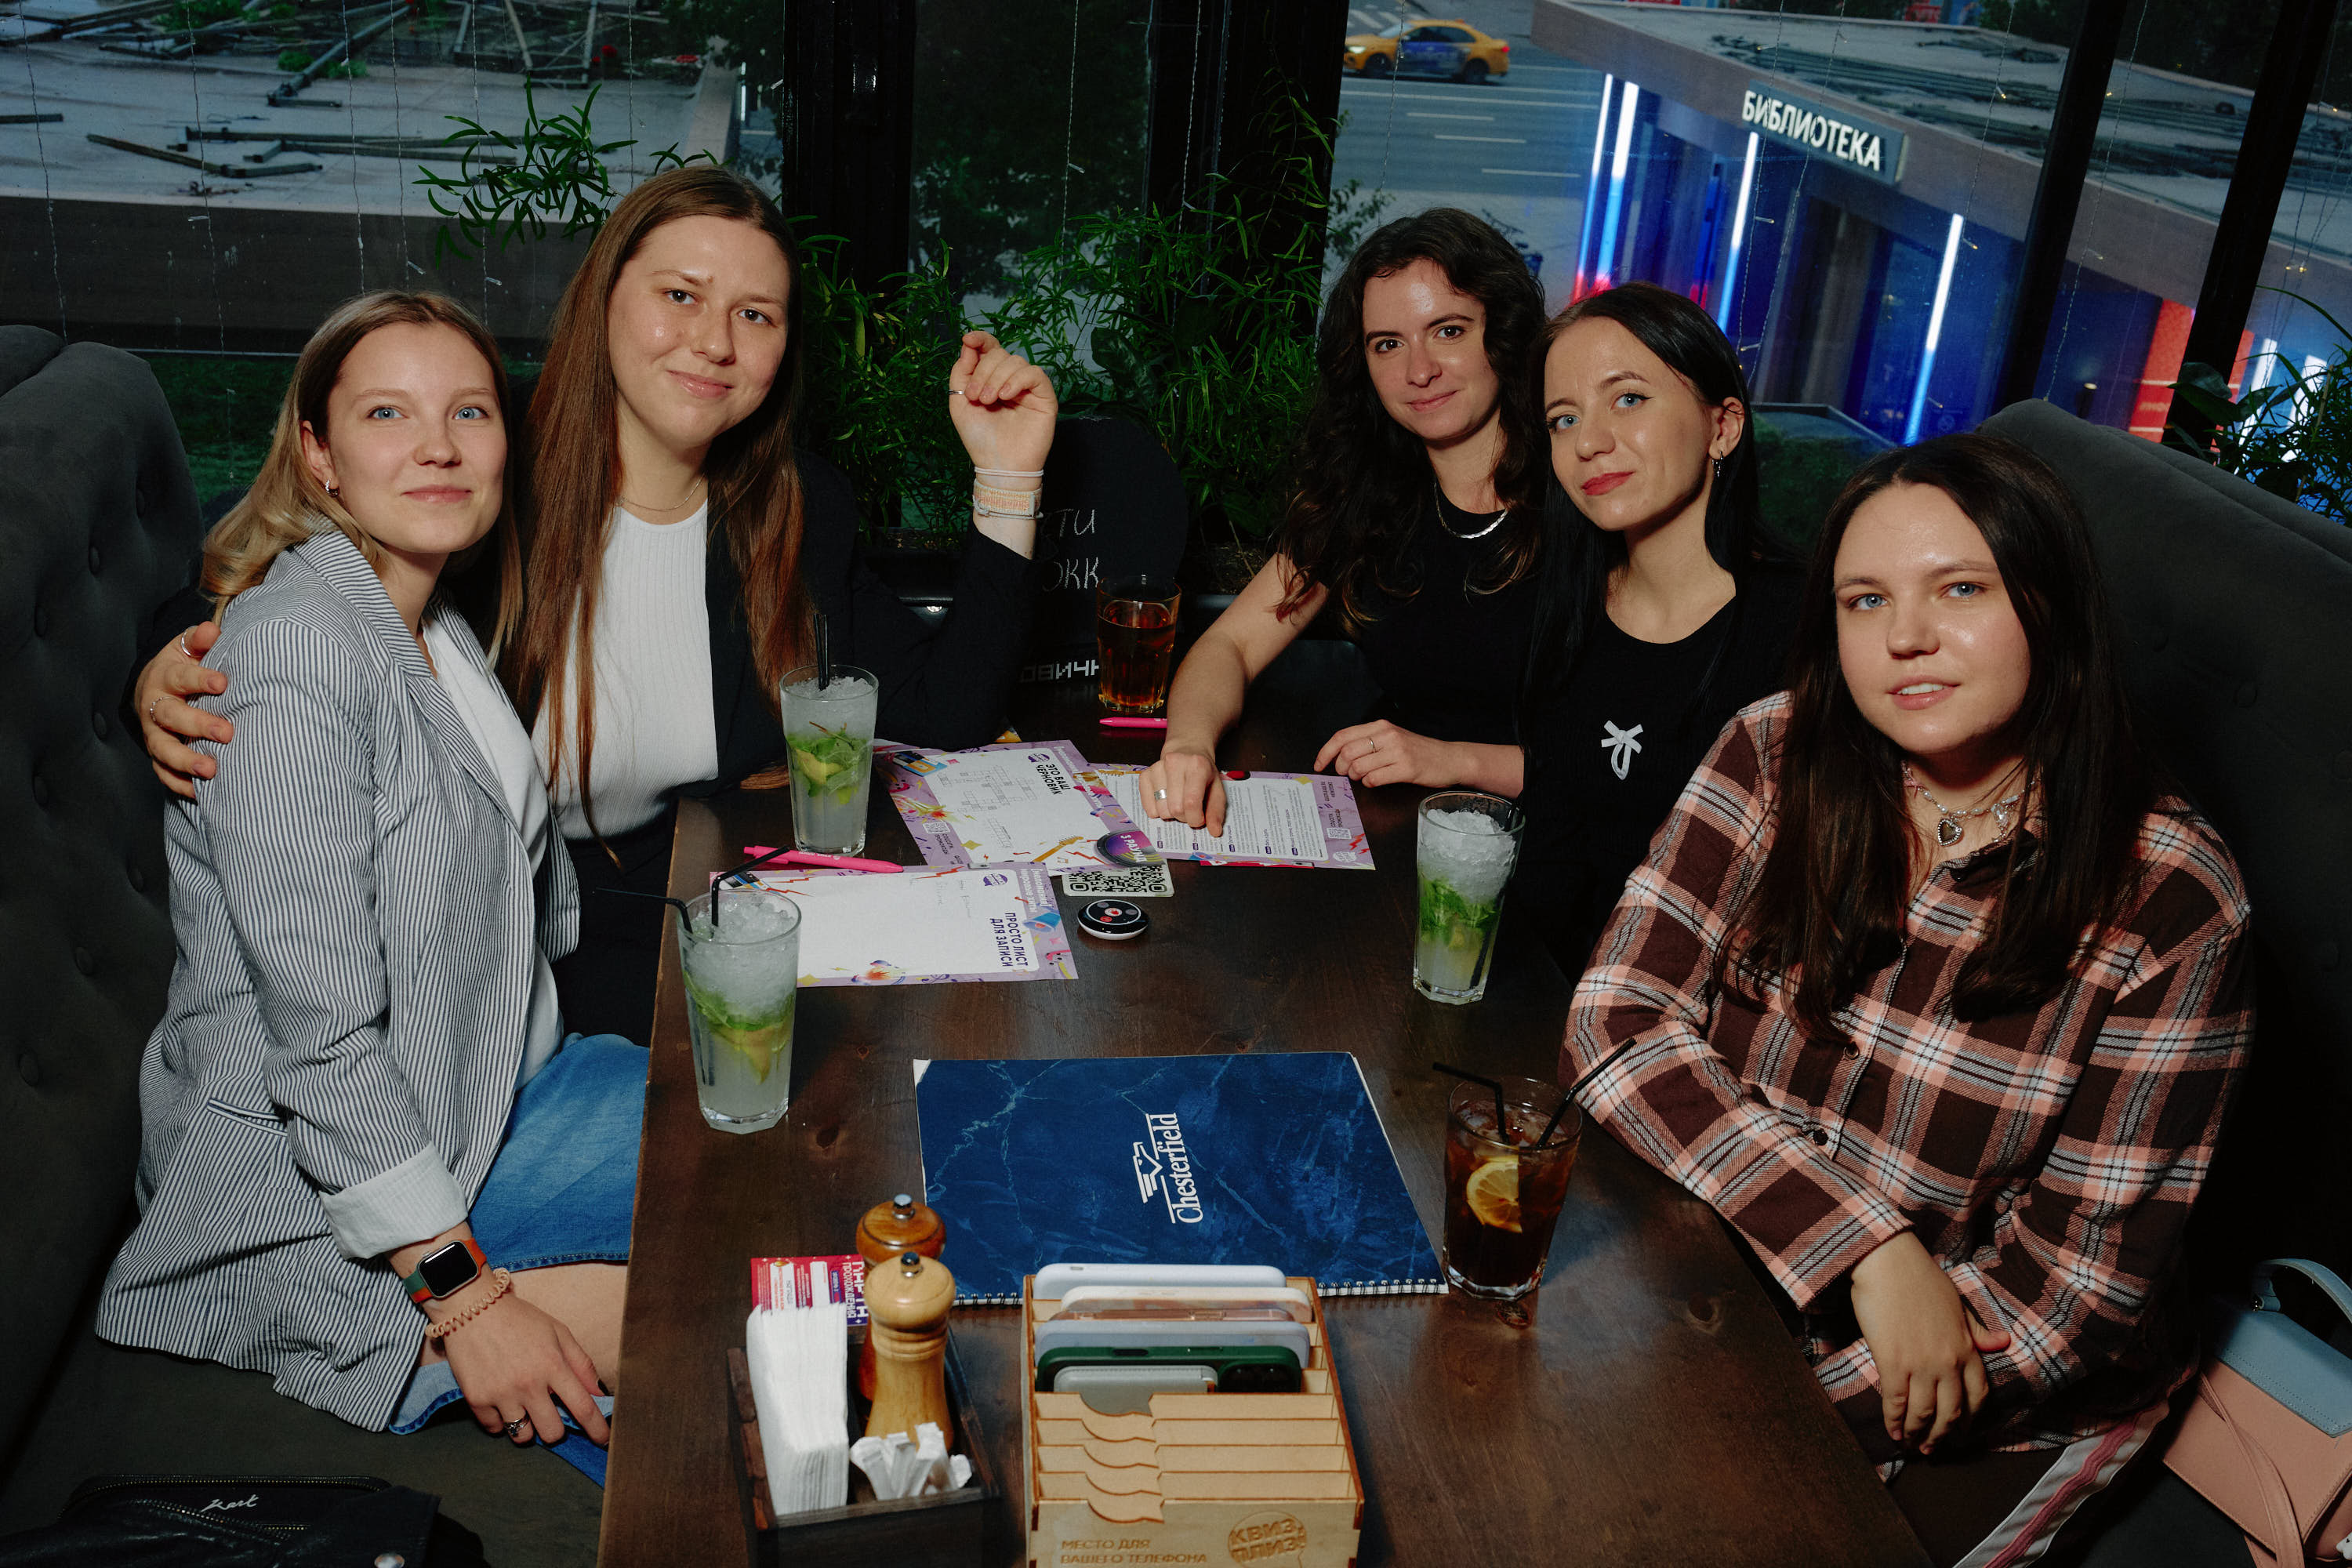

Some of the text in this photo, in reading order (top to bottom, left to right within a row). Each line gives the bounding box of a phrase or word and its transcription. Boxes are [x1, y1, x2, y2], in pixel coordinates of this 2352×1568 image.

[1742, 89, 1880, 172] БИБЛИОТЕКА
[1036, 764, 1062, 795] ЧЕРНОВИК
[1045, 764, 1061, 775] ЭТО
[1054, 776, 1071, 790] ВАШ
[1123, 839, 1148, 862] РАУНД
[989, 918, 1014, 967] ДЛЯ ЗАПИСИ
[1004, 913, 1029, 966] ПРОСТО ЛИСТ
[1149, 1112, 1203, 1224] Chesterfield
[842, 1261, 857, 1319] ПРОХОЖДЕНИЯ
[1060, 1553, 1207, 1564] ВАШЕГО ТЕЛЕФОНА
[1061, 1538, 1151, 1550] МЕСТО ДЛЯ
